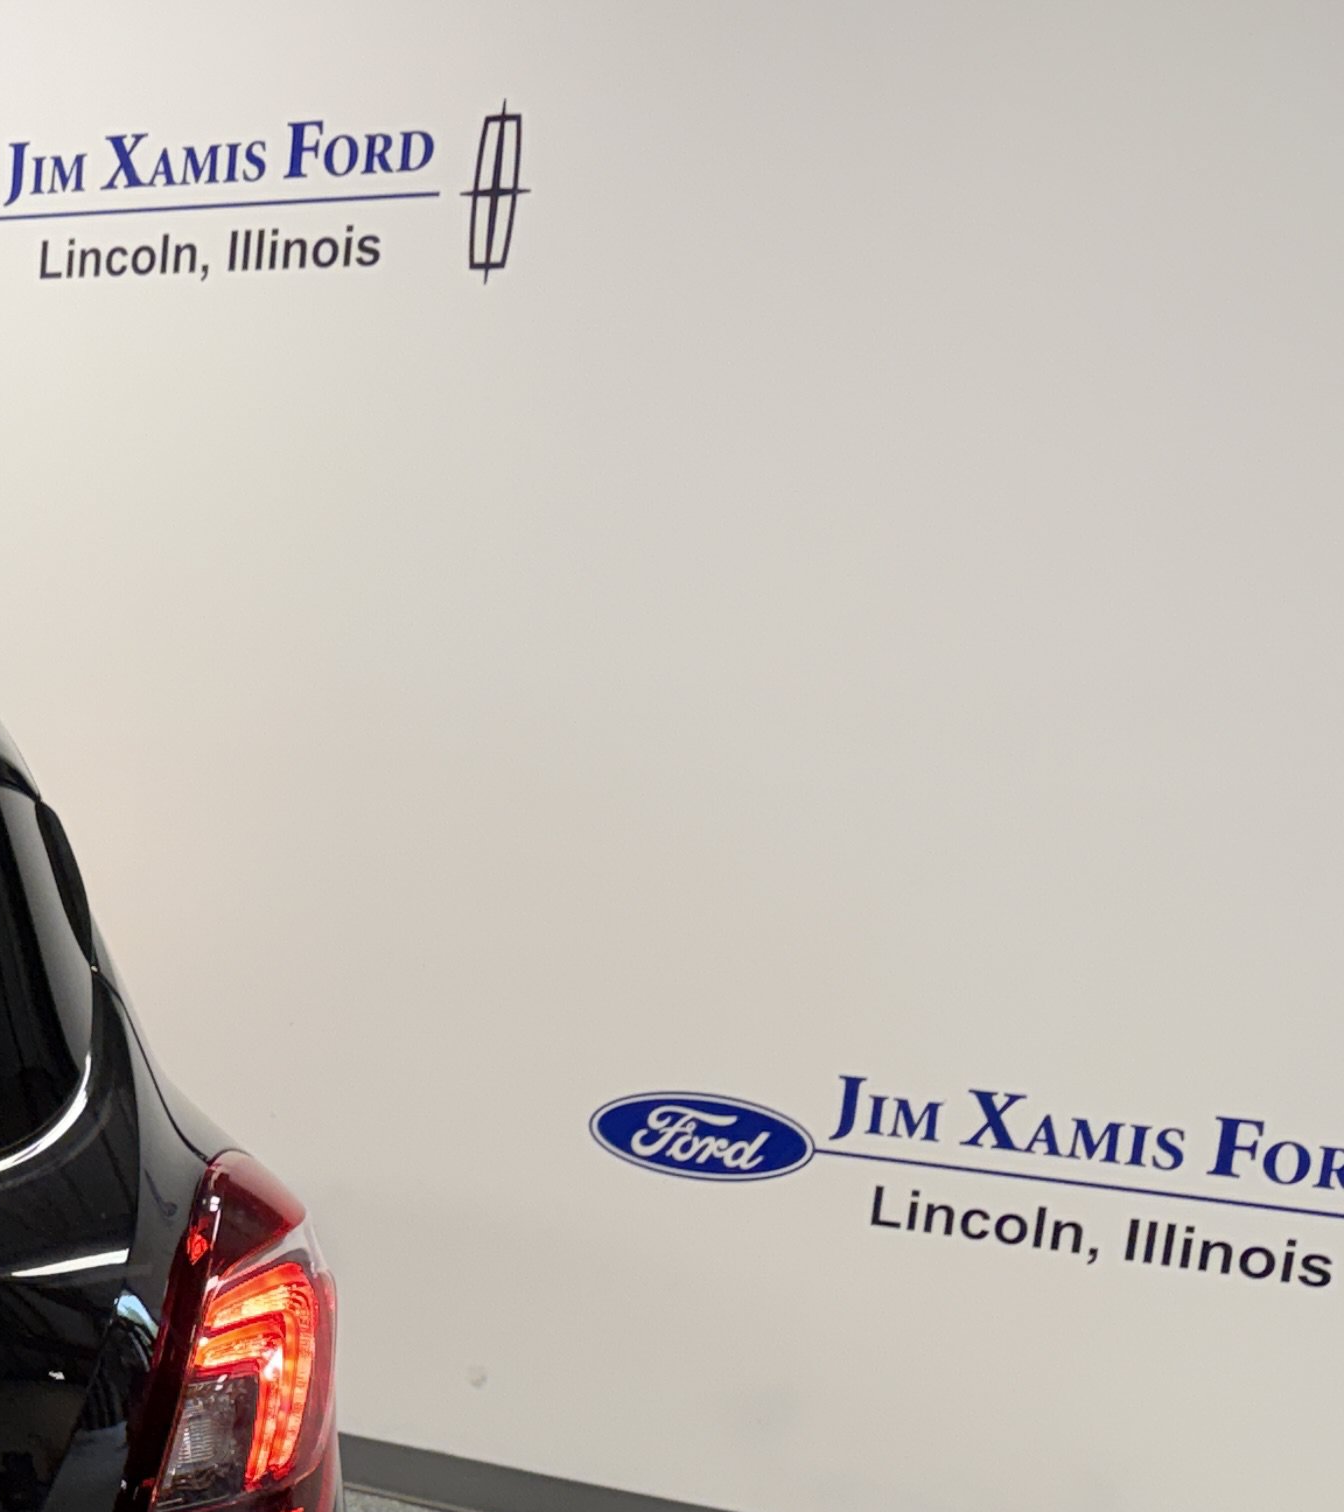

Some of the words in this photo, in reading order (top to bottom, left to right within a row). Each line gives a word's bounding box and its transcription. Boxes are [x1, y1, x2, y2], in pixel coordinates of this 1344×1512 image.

[284, 120, 435, 179] FORD
[39, 234, 210, 281] Lincoln,
[227, 225, 381, 272] Illinois
[630, 1104, 764, 1172] Ford
[869, 1184, 1102, 1265] Lincoln,
[1123, 1217, 1333, 1288] Illinois
